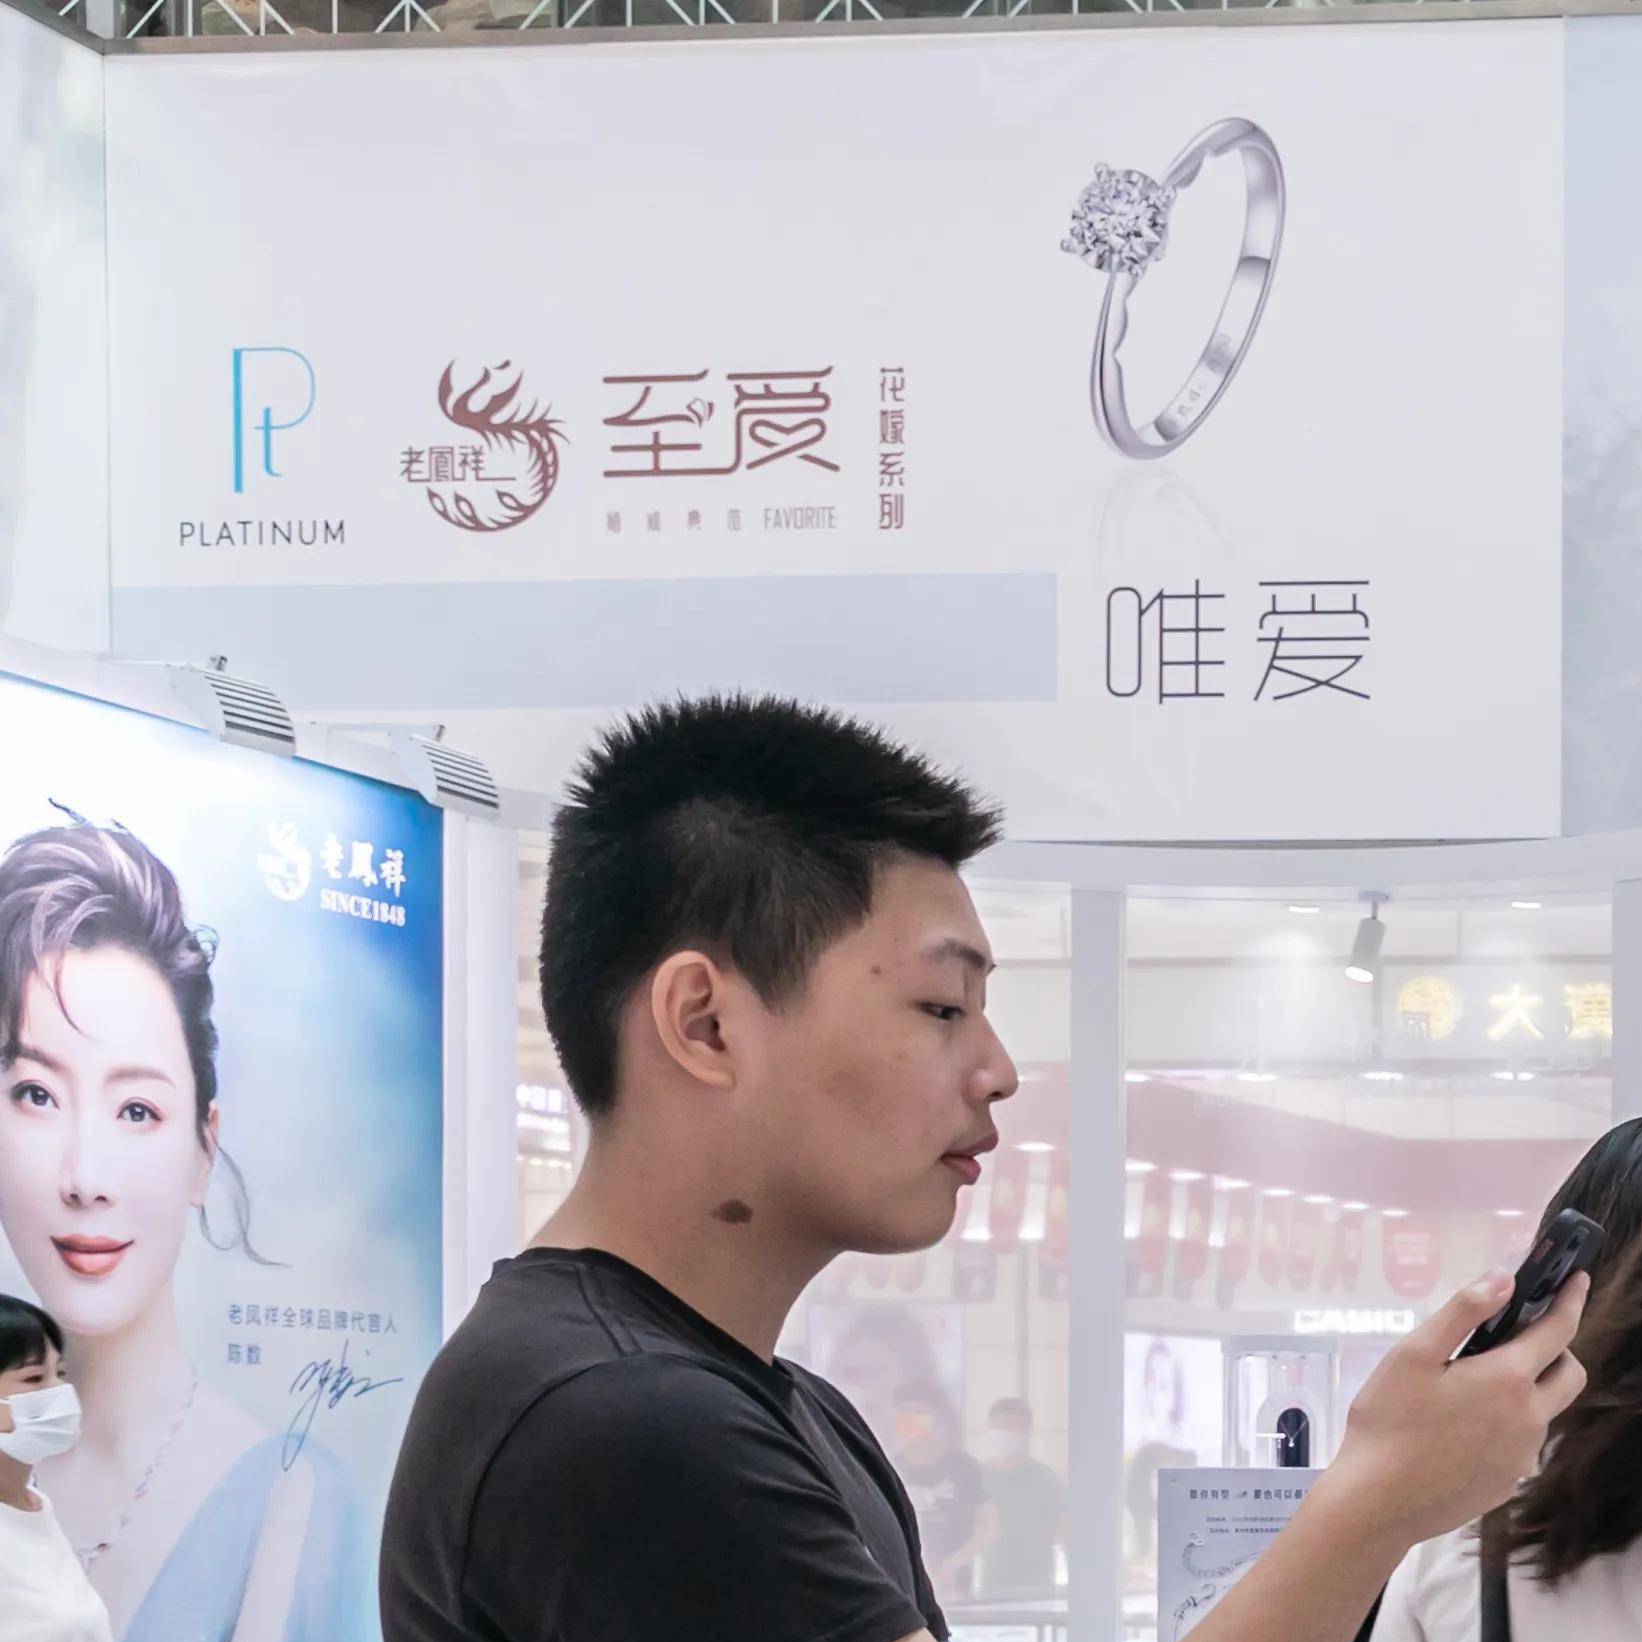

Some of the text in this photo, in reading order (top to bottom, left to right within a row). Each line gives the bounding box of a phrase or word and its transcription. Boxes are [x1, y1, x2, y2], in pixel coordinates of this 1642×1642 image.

[764, 506, 837, 530] FAVORITE
[180, 520, 345, 547] PLATINUM
[1106, 579, 1370, 705] 唯爱
[1293, 1308, 1415, 1335] CASIO
